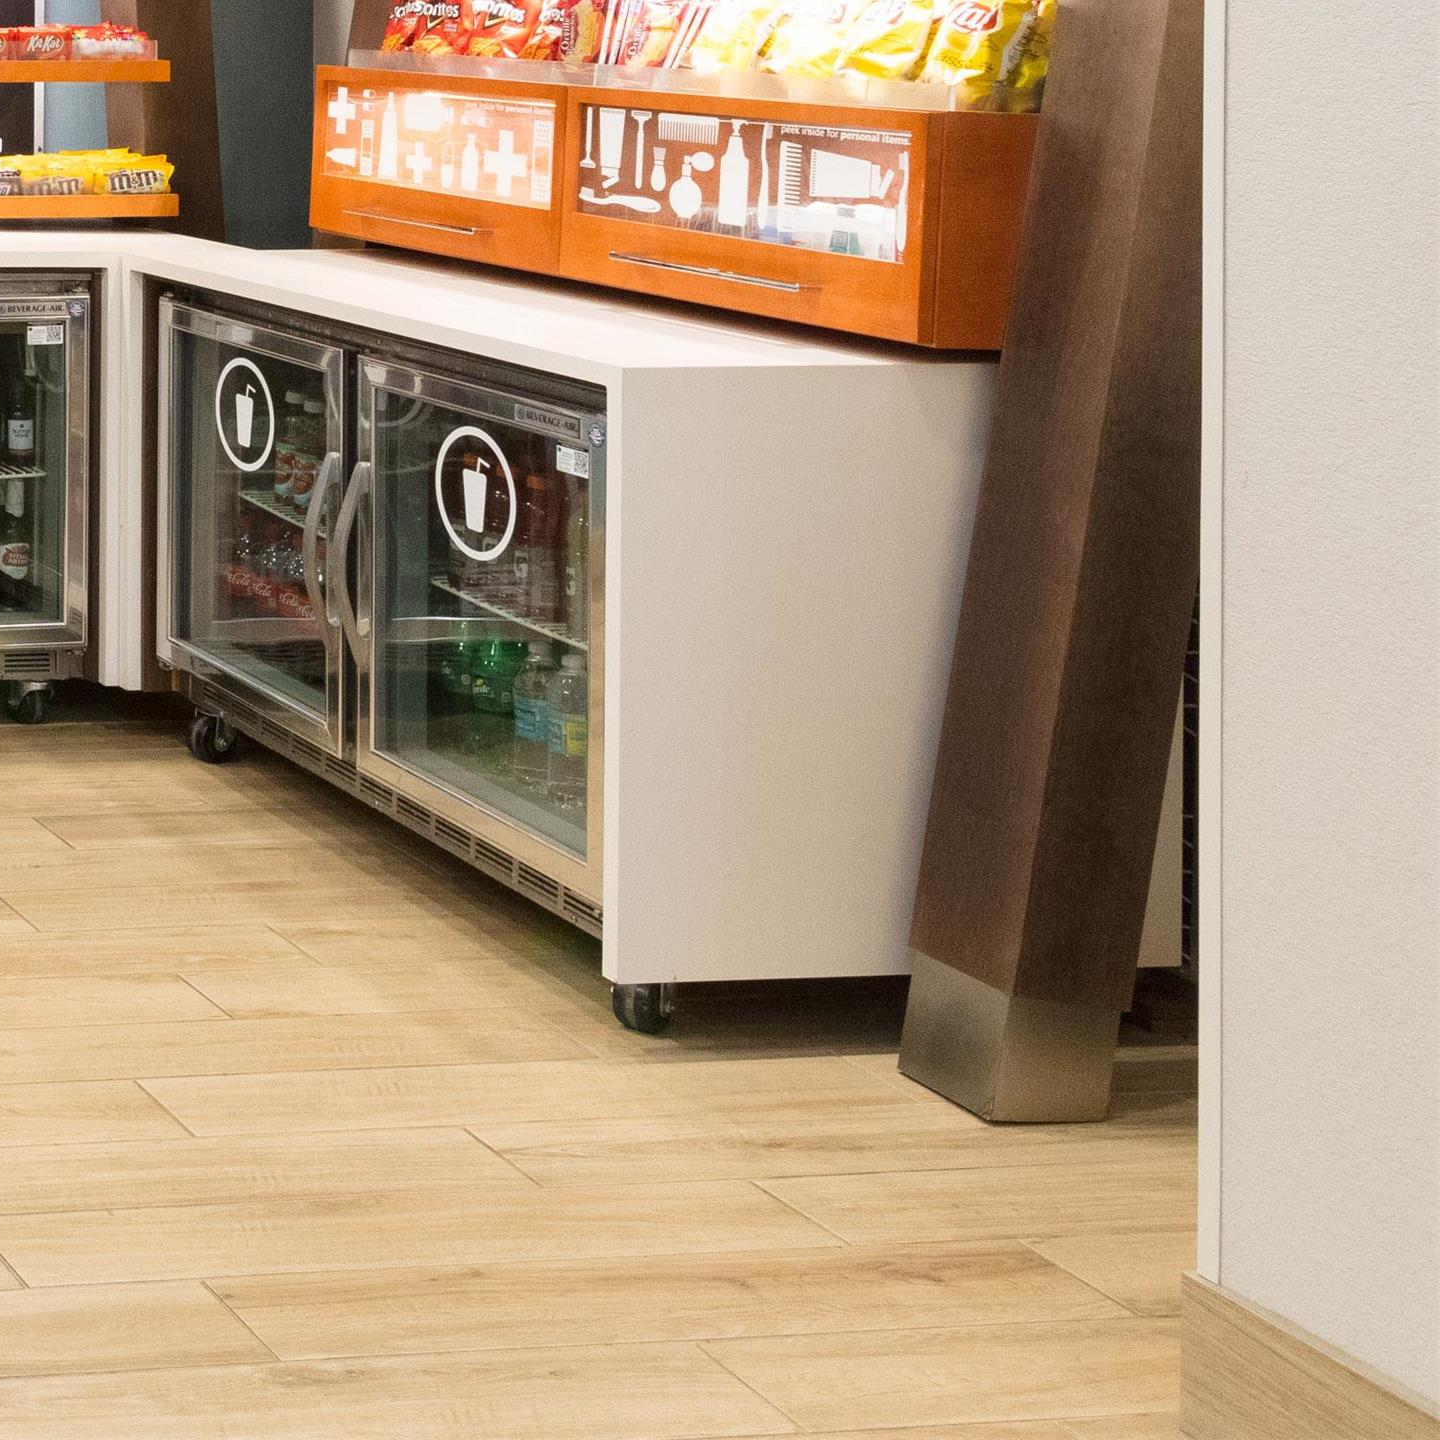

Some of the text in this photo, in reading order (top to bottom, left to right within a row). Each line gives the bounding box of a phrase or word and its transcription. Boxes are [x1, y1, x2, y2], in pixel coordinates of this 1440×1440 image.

[416, 0, 460, 19] Doritos
[780, 125, 912, 146] peek inside for personal items.
